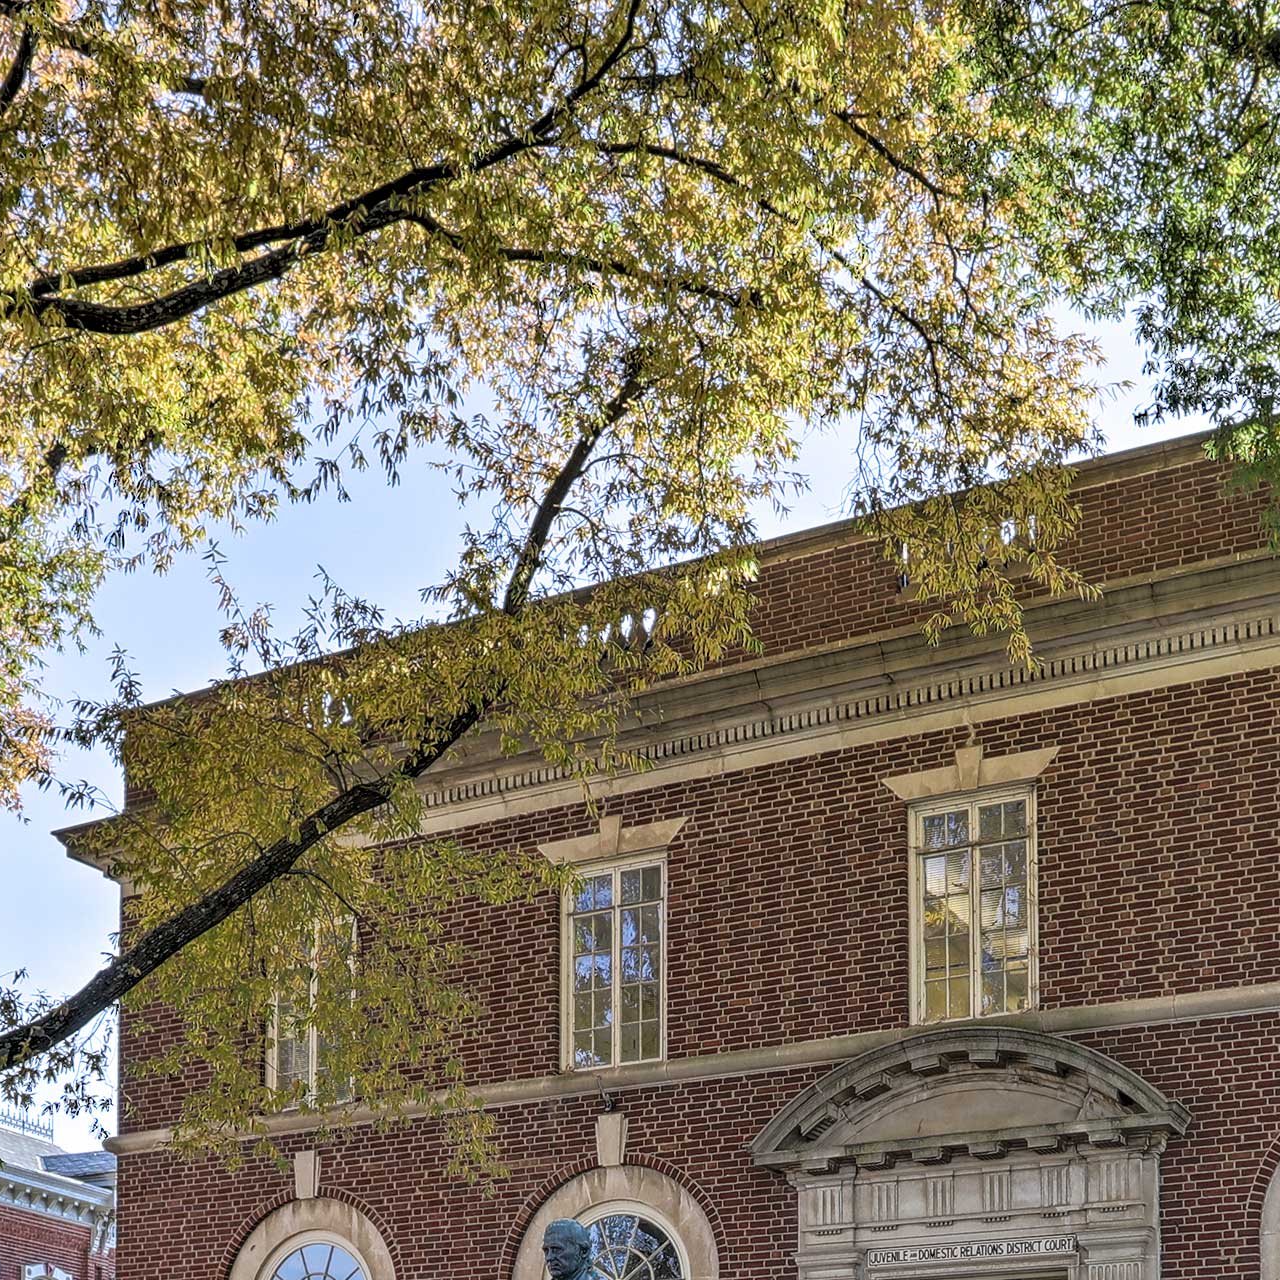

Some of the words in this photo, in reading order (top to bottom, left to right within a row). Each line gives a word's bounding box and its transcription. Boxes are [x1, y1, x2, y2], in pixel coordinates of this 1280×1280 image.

[870, 1250, 908, 1264] JUVENILE
[919, 1246, 959, 1261] DOMESTIC
[960, 1242, 1004, 1258] RELATIONS
[1006, 1240, 1042, 1255] DISTRICT
[1044, 1239, 1072, 1251] COURT
